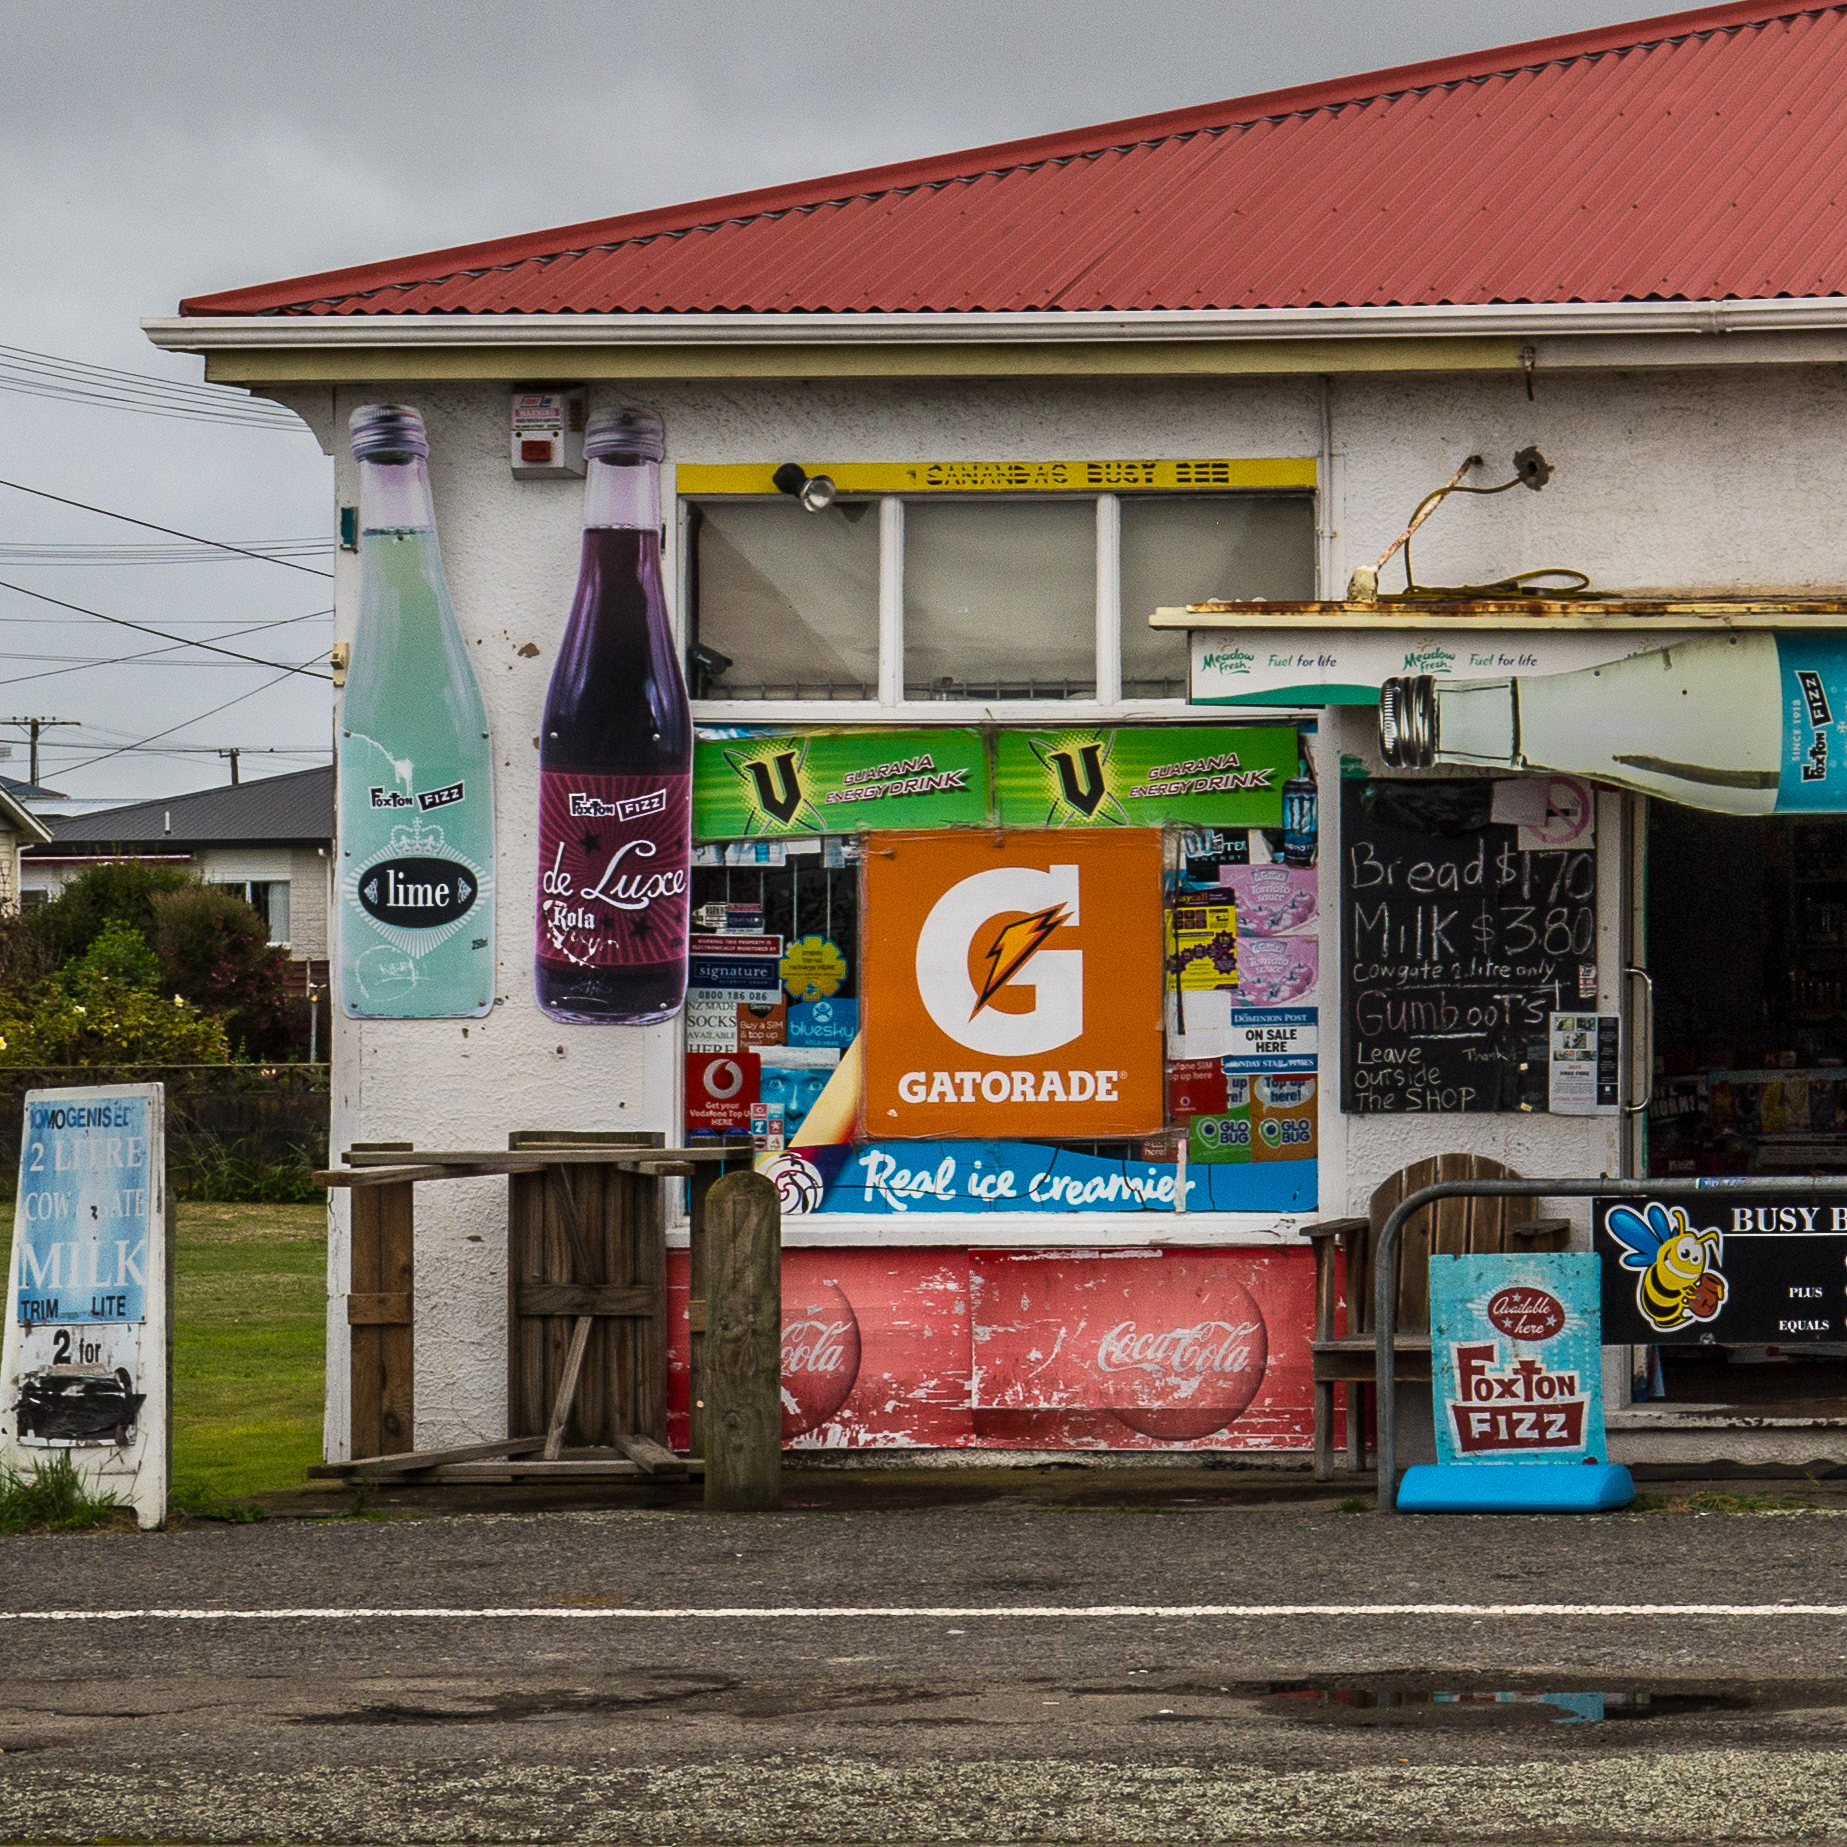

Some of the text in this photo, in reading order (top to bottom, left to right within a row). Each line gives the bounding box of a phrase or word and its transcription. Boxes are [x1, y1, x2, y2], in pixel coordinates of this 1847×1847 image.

[1176, 463, 1230, 483] BEE
[1201, 647, 1255, 671] Meadow
[1268, 654, 1338, 668] Fuel for life
[1402, 646, 1456, 671] Meadow
[1469, 654, 1538, 668] Fuel for life
[844, 755, 934, 785] GUARANA
[1148, 752, 1240, 780] GUARANA
[743, 751, 801, 824] V
[826, 769, 969, 804] ENERGY DRINK
[1047, 744, 1105, 817] V
[1129, 768, 1274, 798] ENERGY DRINK
[424, 783, 460, 807] FIZZ
[625, 797, 661, 815] FIZZ
[543, 840, 686, 910] de Luxe
[1350, 838, 1485, 893] Bread
[386, 869, 449, 907] lime
[554, 906, 595, 931] Kola
[1472, 898, 1594, 956] $3.80
[915, 864, 1084, 1056] G
[700, 964, 768, 980] signature
[699, 991, 768, 1001] 0800 186 086
[710, 1002, 736, 1010] MADE
[688, 1016, 737, 1028] SOCKS
[740, 1021, 757, 1029] Buy
[1233, 1014, 1308, 1023] DOMINION POST
[748, 1031, 777, 1040] top up
[790, 1021, 854, 1041] bluesky
[1246, 1029, 1298, 1041] ON SALE
[689, 1044, 735, 1053] HERE
[1256, 1042, 1287, 1053] HERE
[1357, 1042, 1422, 1065] Leave
[1196, 1061, 1213, 1069] SIM
[898, 1071, 1119, 1103] GATORADE
[1180, 1073, 1192, 1081] up
[1232, 1078, 1248, 1089] up
[1270, 1089, 1302, 1102] here!
[1405, 1087, 1476, 1112] SHOP
[1220, 1121, 1249, 1131] GLO
[1281, 1120, 1310, 1131] GLO
[1220, 1133, 1249, 1143] BUG
[1282, 1132, 1311, 1142] BUG
[30, 1143, 45, 1171] 2
[857, 1150, 1195, 1211] Real ice creamier
[1731, 1208, 1817, 1233] BUSY
[18, 1240, 146, 1289] MILK
[1789, 1286, 1823, 1298] PLUS
[21, 1296, 126, 1320] TRIM LITE
[1493, 1296, 1552, 1315] Available
[1514, 1315, 1545, 1334] here
[1778, 1318, 1830, 1332] EQUALS
[53, 1330, 102, 1364] 2 for
[1097, 1320, 1262, 1375] Coca-Cola
[1457, 1344, 1576, 1402] FOXTON
[1468, 1412, 1569, 1440] FIZZ
